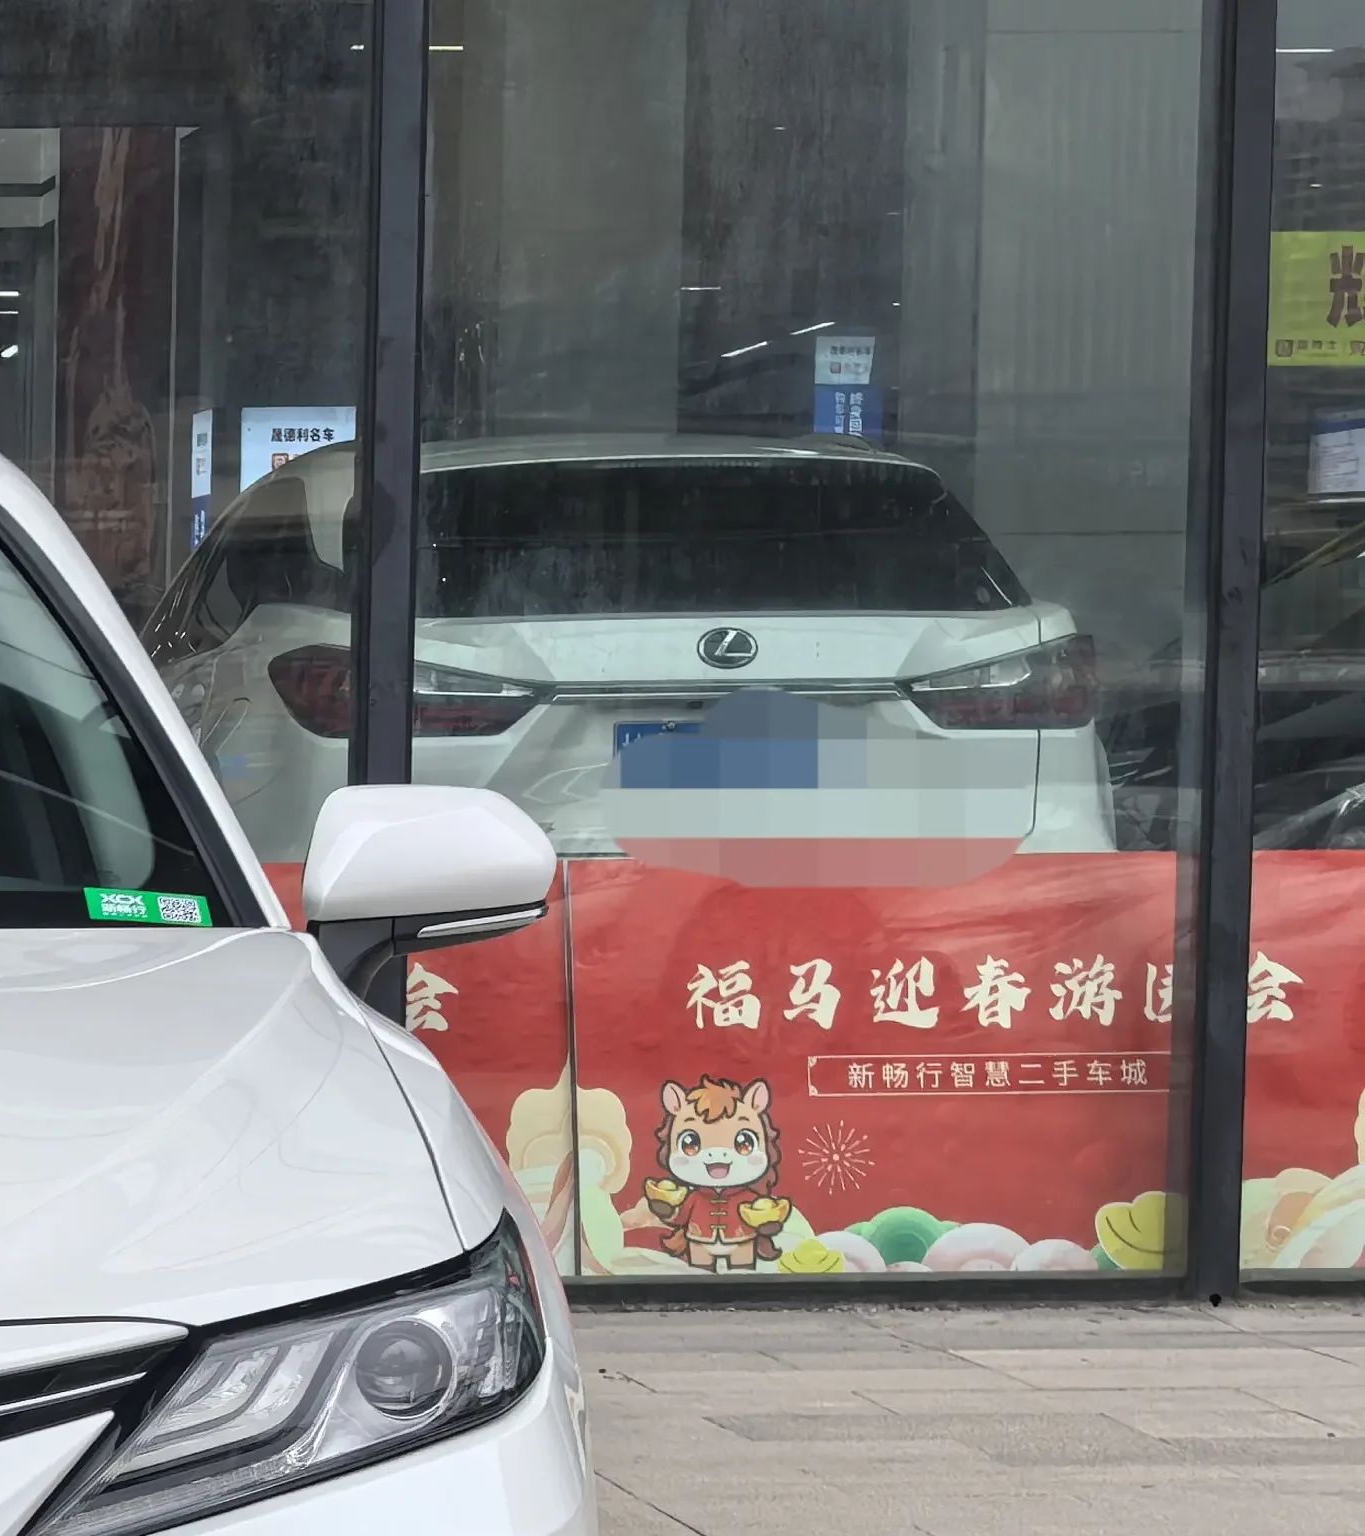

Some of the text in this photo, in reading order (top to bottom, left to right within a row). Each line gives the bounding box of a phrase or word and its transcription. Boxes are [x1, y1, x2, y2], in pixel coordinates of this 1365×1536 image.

[847, 1057, 1150, 1090] 新畅行智慧二手车城
